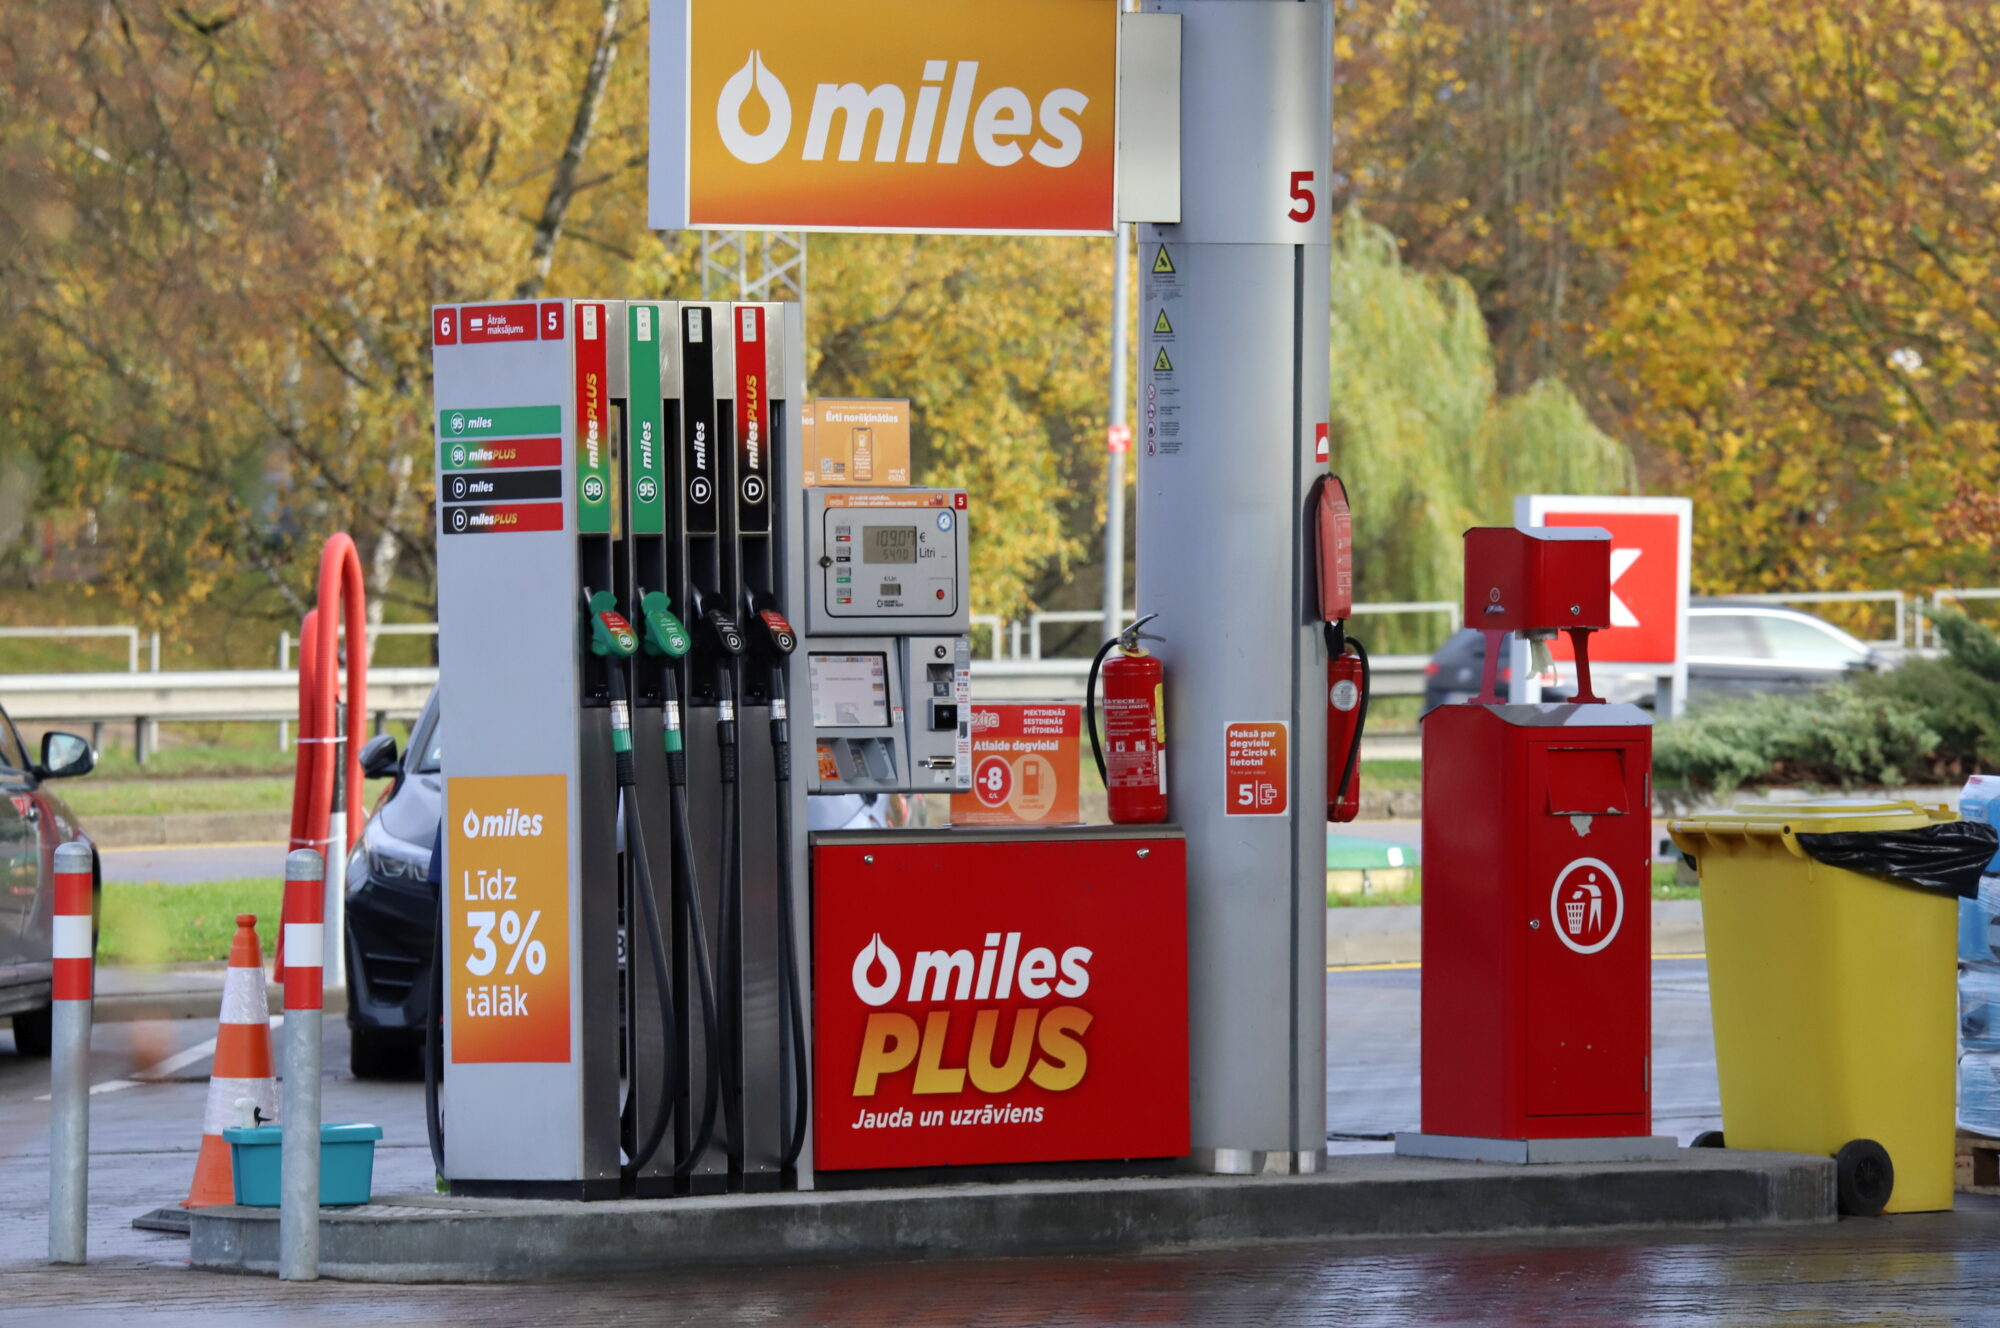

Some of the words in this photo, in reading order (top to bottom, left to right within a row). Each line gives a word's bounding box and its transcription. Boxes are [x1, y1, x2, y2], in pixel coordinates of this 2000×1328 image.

[801, 60, 1090, 168] miles
[1287, 171, 1316, 223] 5
[441, 317, 451, 336] 6
[487, 314, 507, 325] Ātrais
[548, 312, 557, 331] 5
[487, 325, 524, 336] maksājums
[452, 418, 463, 430] 95
[468, 417, 492, 429] miles
[640, 421, 652, 469] miles
[693, 421, 706, 470] miles
[453, 450, 464, 462] 98
[456, 482, 464, 493] D
[469, 481, 494, 493] miles
[585, 482, 602, 496] 98
[639, 483, 655, 497] 95
[695, 483, 707, 497] D
[748, 483, 760, 497] D
[958, 498, 964, 506] 5
[456, 514, 464, 526] D
[920, 547, 935, 558] Litri
[621, 637, 632, 645] 98
[672, 637, 683, 646] 95
[1023, 708, 1066, 716] PIEKTDIENĀS
[1023, 717, 1063, 725] SESTDIENĀS
[1023, 726, 1063, 734] SVĒTDIENĀS
[1230, 730, 1259, 738] Maksā
[1261, 731, 1276, 739] par
[973, 740, 1010, 751] Atlaide
[1012, 740, 1059, 752] degvielai
[1230, 739, 1270, 748] degvielu
[1242, 749, 1268, 757] Circle
[1270, 749, 1277, 757] K
[1230, 758, 1263, 766] lietotni
[978, 766, 1003, 791] -8
[1238, 784, 1254, 805] 5
[481, 808, 543, 837] miles
[463, 868, 517, 900] Līdz
[465, 910, 547, 976] 3%
[907, 931, 1093, 1002] miles
[466, 985, 528, 1017] tālāk
[852, 1005, 1094, 1097] PLUS
[852, 1107, 913, 1129] Jauda
[920, 1108, 944, 1126] un
[950, 1104, 1044, 1125] uzrāviens
